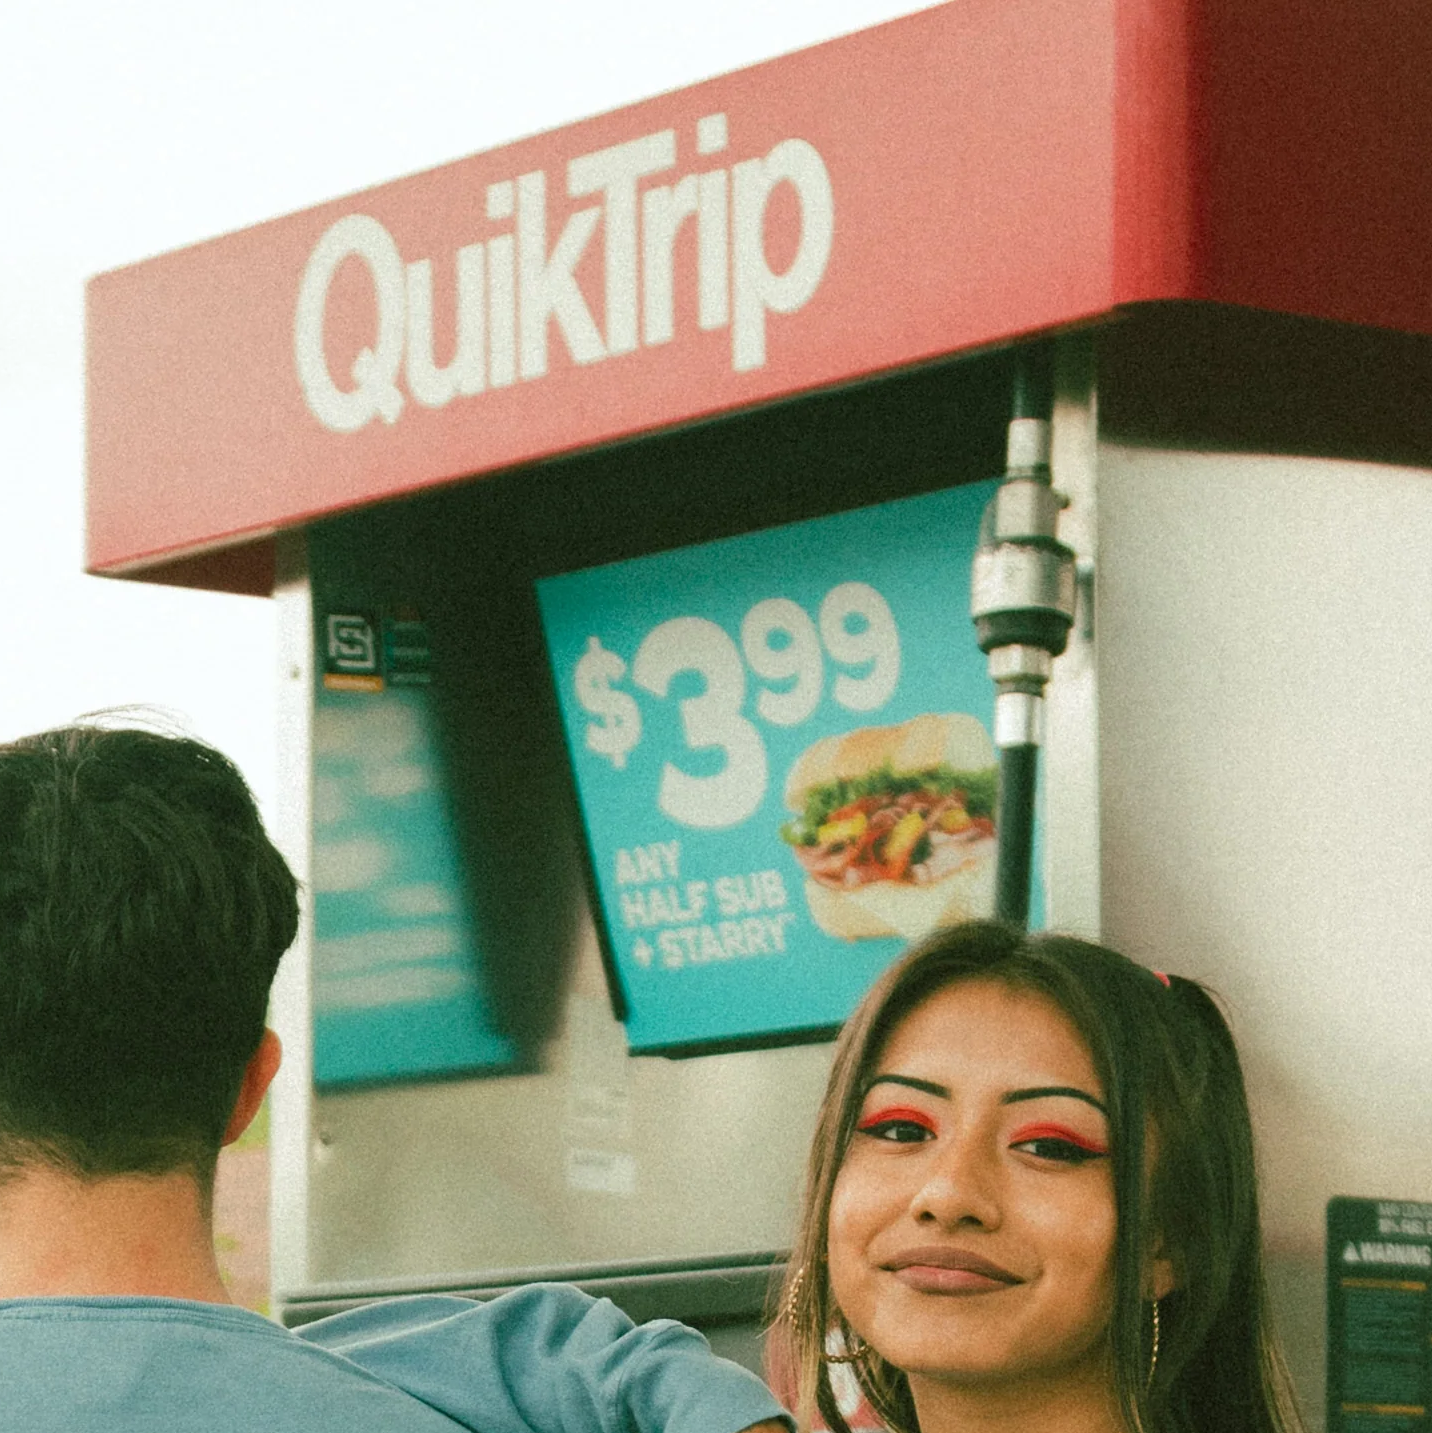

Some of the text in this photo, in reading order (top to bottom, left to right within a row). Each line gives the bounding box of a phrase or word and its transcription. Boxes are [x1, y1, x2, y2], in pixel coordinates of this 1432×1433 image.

[293, 112, 834, 432] QuikTrip
[616, 840, 680, 884] ANY
[621, 869, 787, 928] HALF SUB
[658, 915, 789, 969] STARRY
[1360, 1241, 1432, 1267] WARNING
